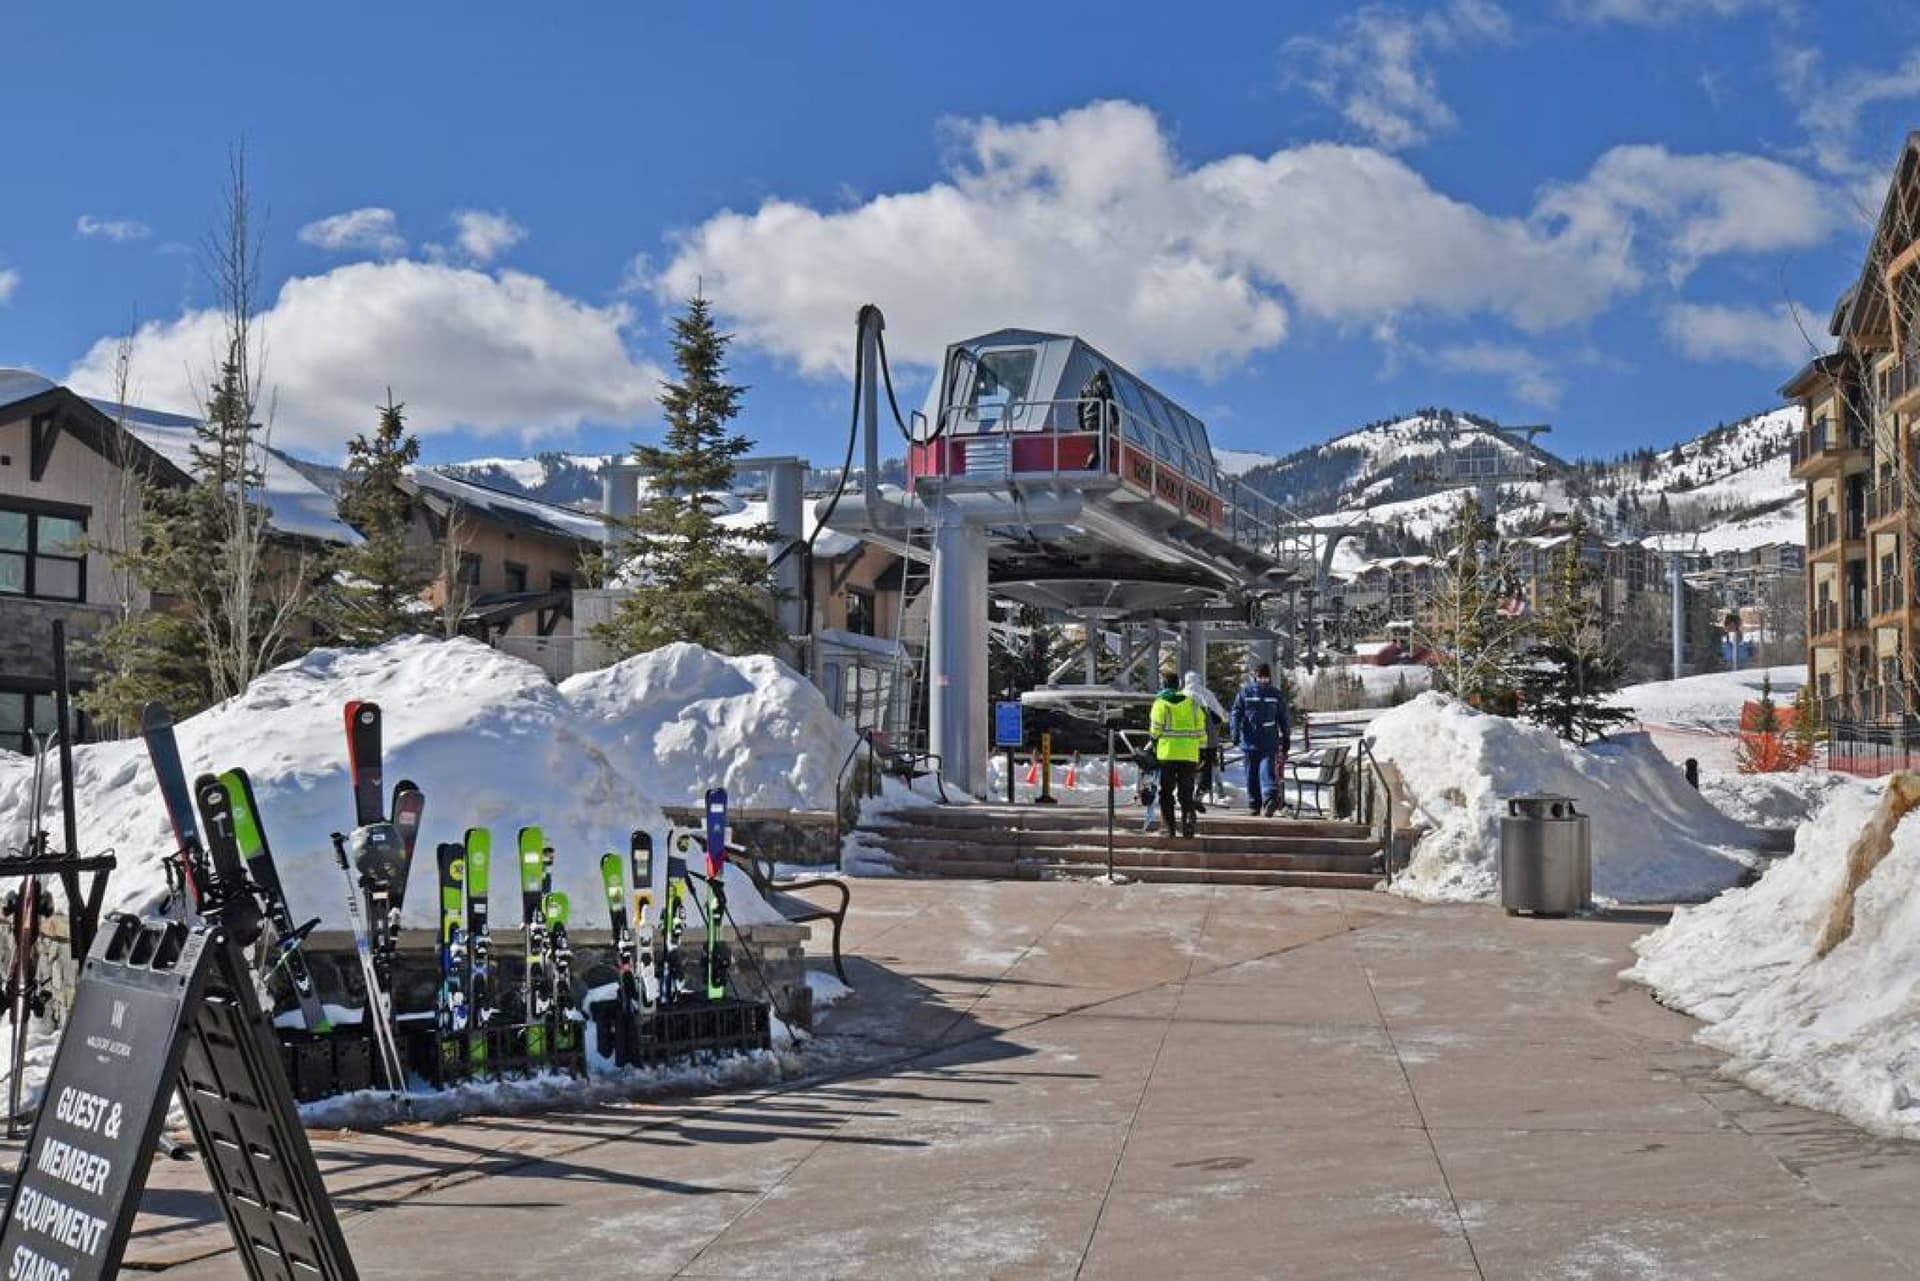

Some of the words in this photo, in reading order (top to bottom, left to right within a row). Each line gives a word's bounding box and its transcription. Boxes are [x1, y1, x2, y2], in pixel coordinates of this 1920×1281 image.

[56, 1085, 109, 1132] GUEST
[104, 1102, 122, 1140] &
[37, 1136, 110, 1195] MEMBER
[14, 1186, 108, 1256] EQUIPMENT
